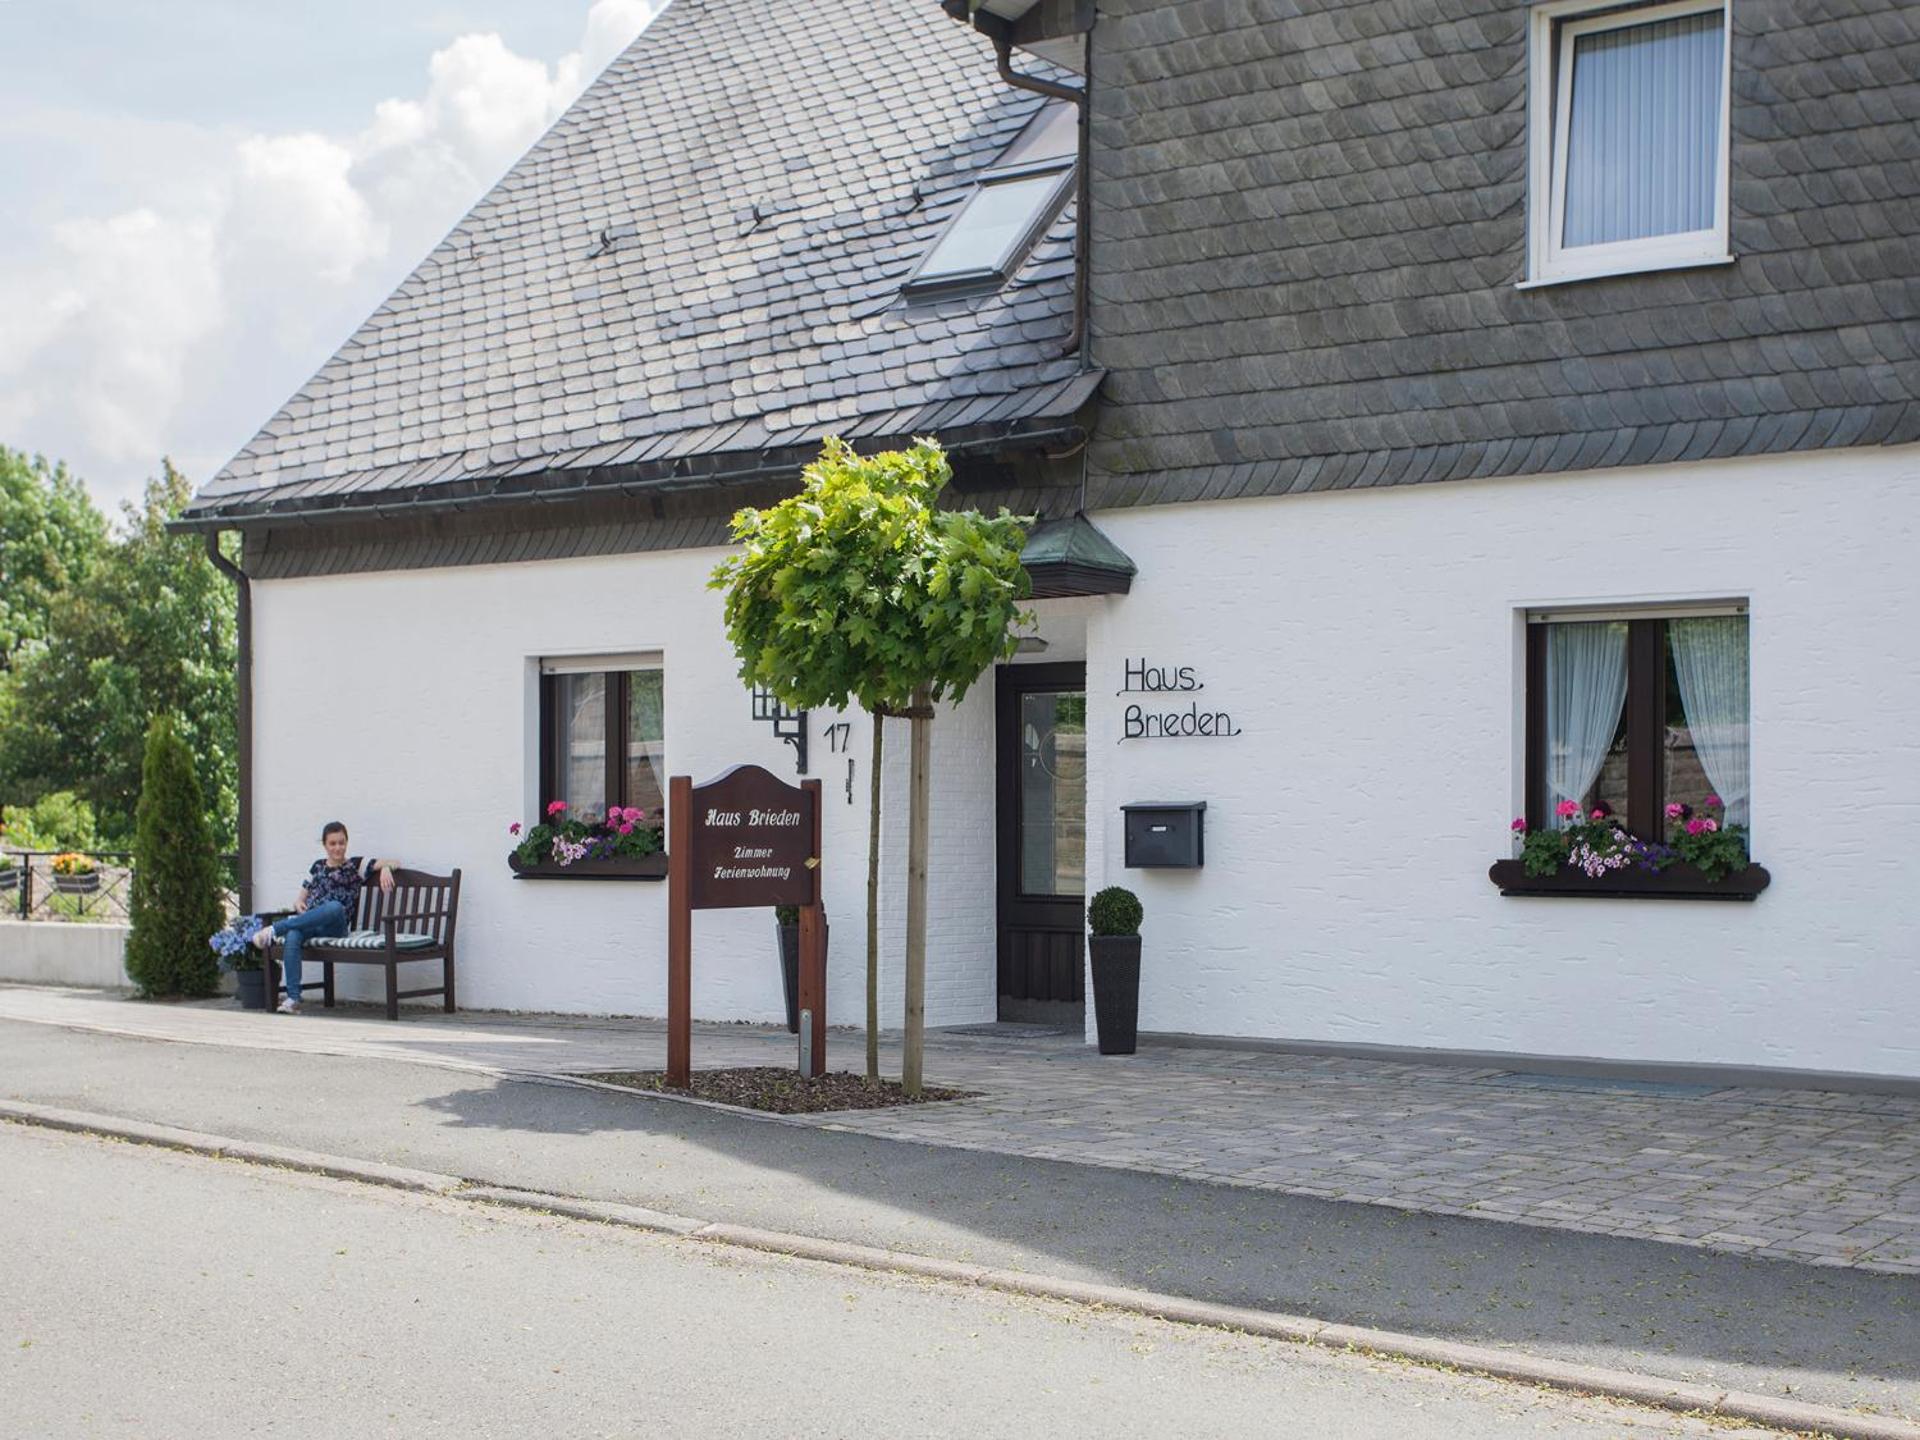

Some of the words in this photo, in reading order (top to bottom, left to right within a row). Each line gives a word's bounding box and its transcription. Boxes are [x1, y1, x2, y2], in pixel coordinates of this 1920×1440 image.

[1124, 657, 1196, 692] Haus
[1124, 701, 1231, 739] Brieden
[823, 723, 850, 753] 17
[705, 809, 741, 826] Haus
[749, 809, 801, 826] Brieden
[734, 846, 773, 859] Zimmer
[714, 865, 791, 880] Ferienwohnung
